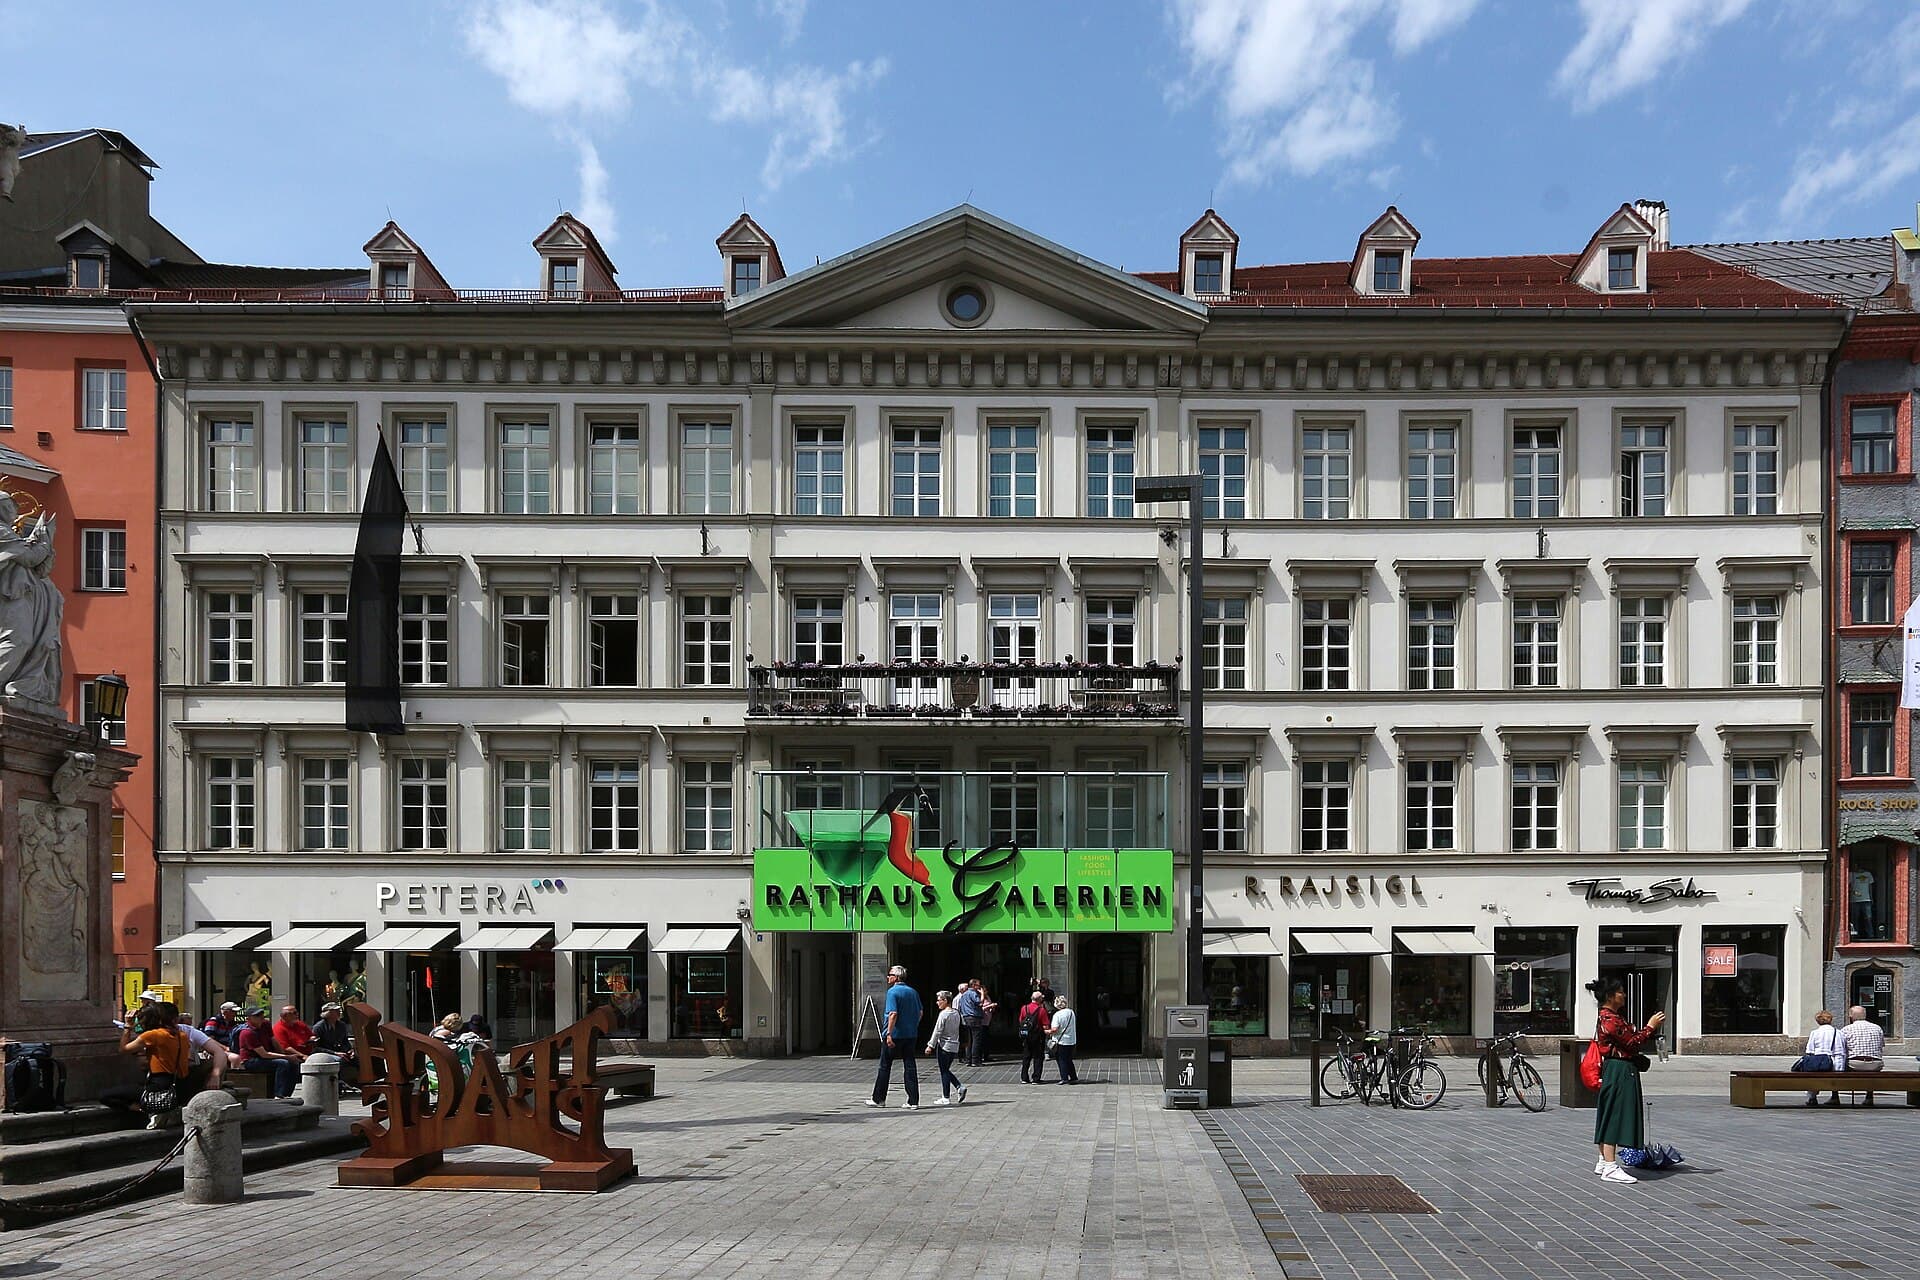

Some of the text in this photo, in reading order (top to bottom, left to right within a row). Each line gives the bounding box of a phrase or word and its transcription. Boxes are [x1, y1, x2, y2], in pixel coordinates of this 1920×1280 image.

[1839, 799, 1918, 809] ROCK SHOP
[376, 882, 535, 911] PETERA
[766, 839, 1162, 934] RATHAUS GALERIEN
[1244, 875, 1423, 896] R. RAJSIGL
[1567, 877, 1717, 904] Thomas Sabo
[1706, 956, 1733, 965] SALE
